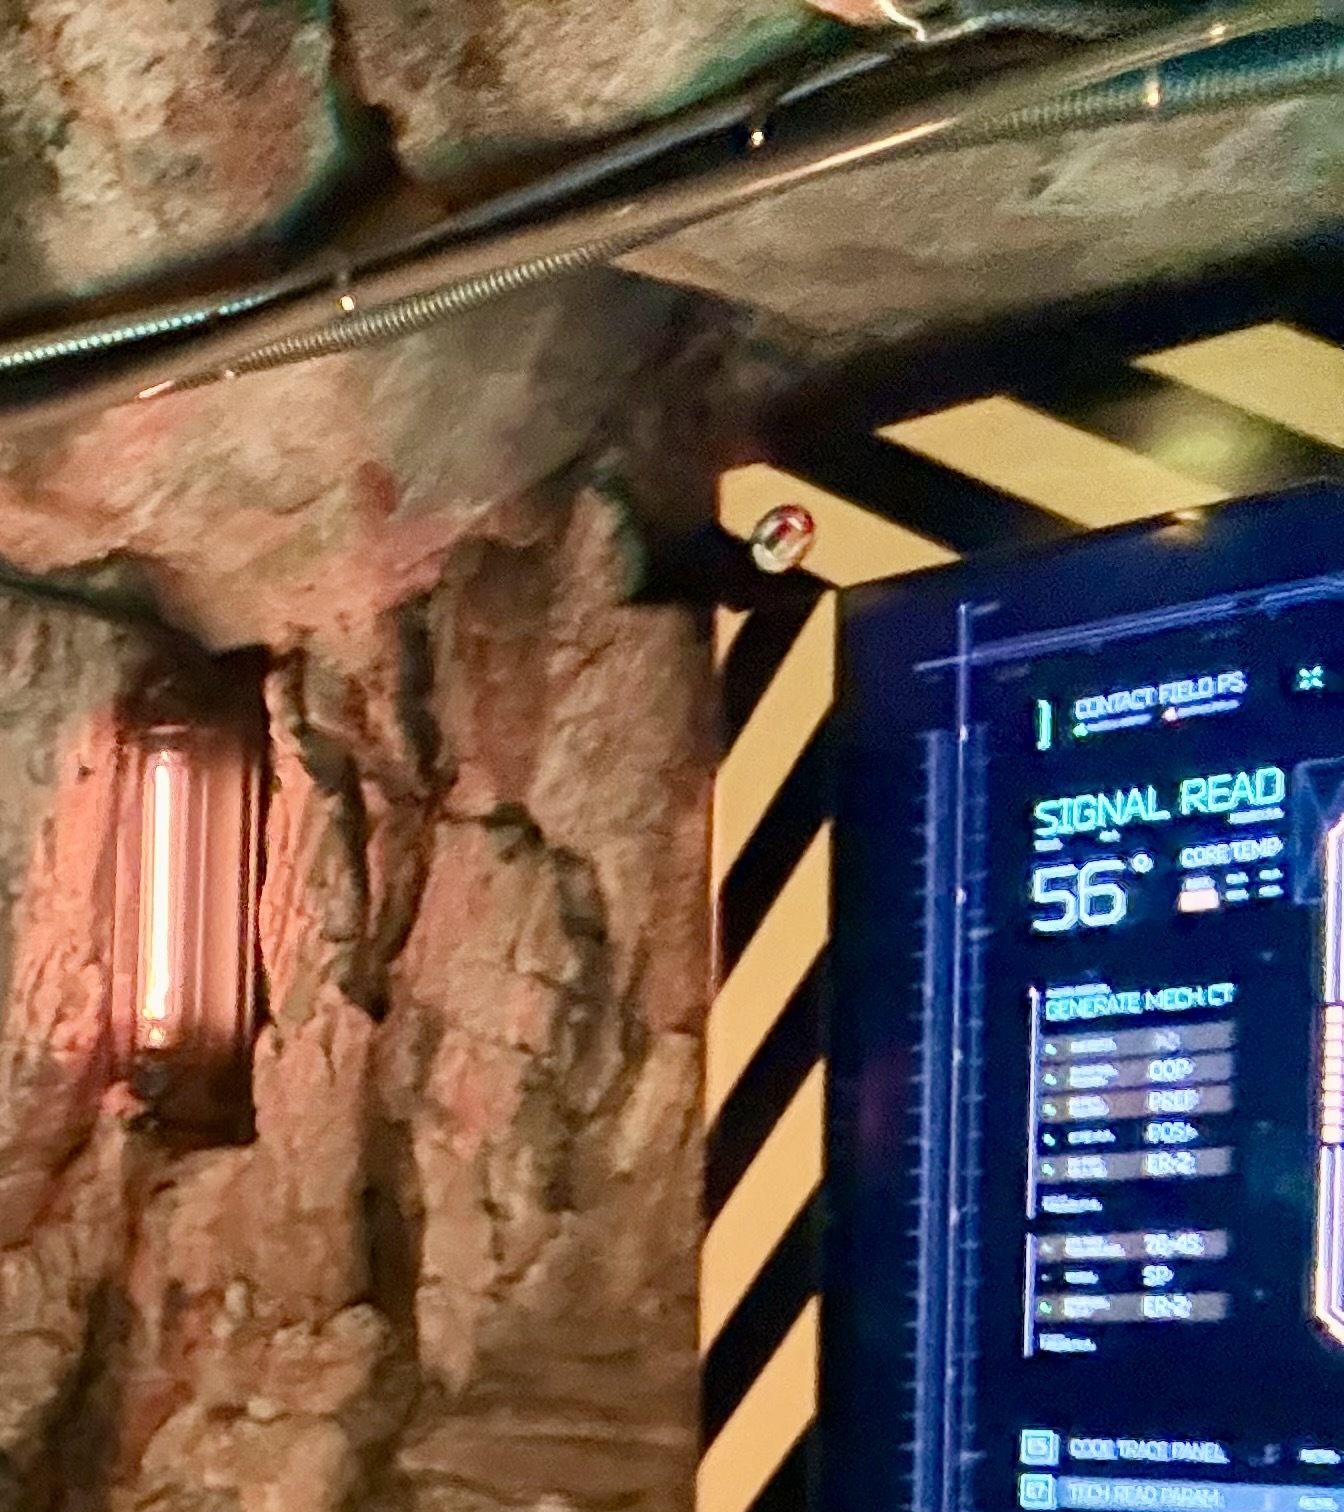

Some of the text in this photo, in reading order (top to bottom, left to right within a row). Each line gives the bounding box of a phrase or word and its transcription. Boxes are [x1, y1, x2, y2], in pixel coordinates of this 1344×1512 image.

[1034, 767, 1286, 837] SIGNAL READ
[1045, 992, 1144, 1021] GENERATE
